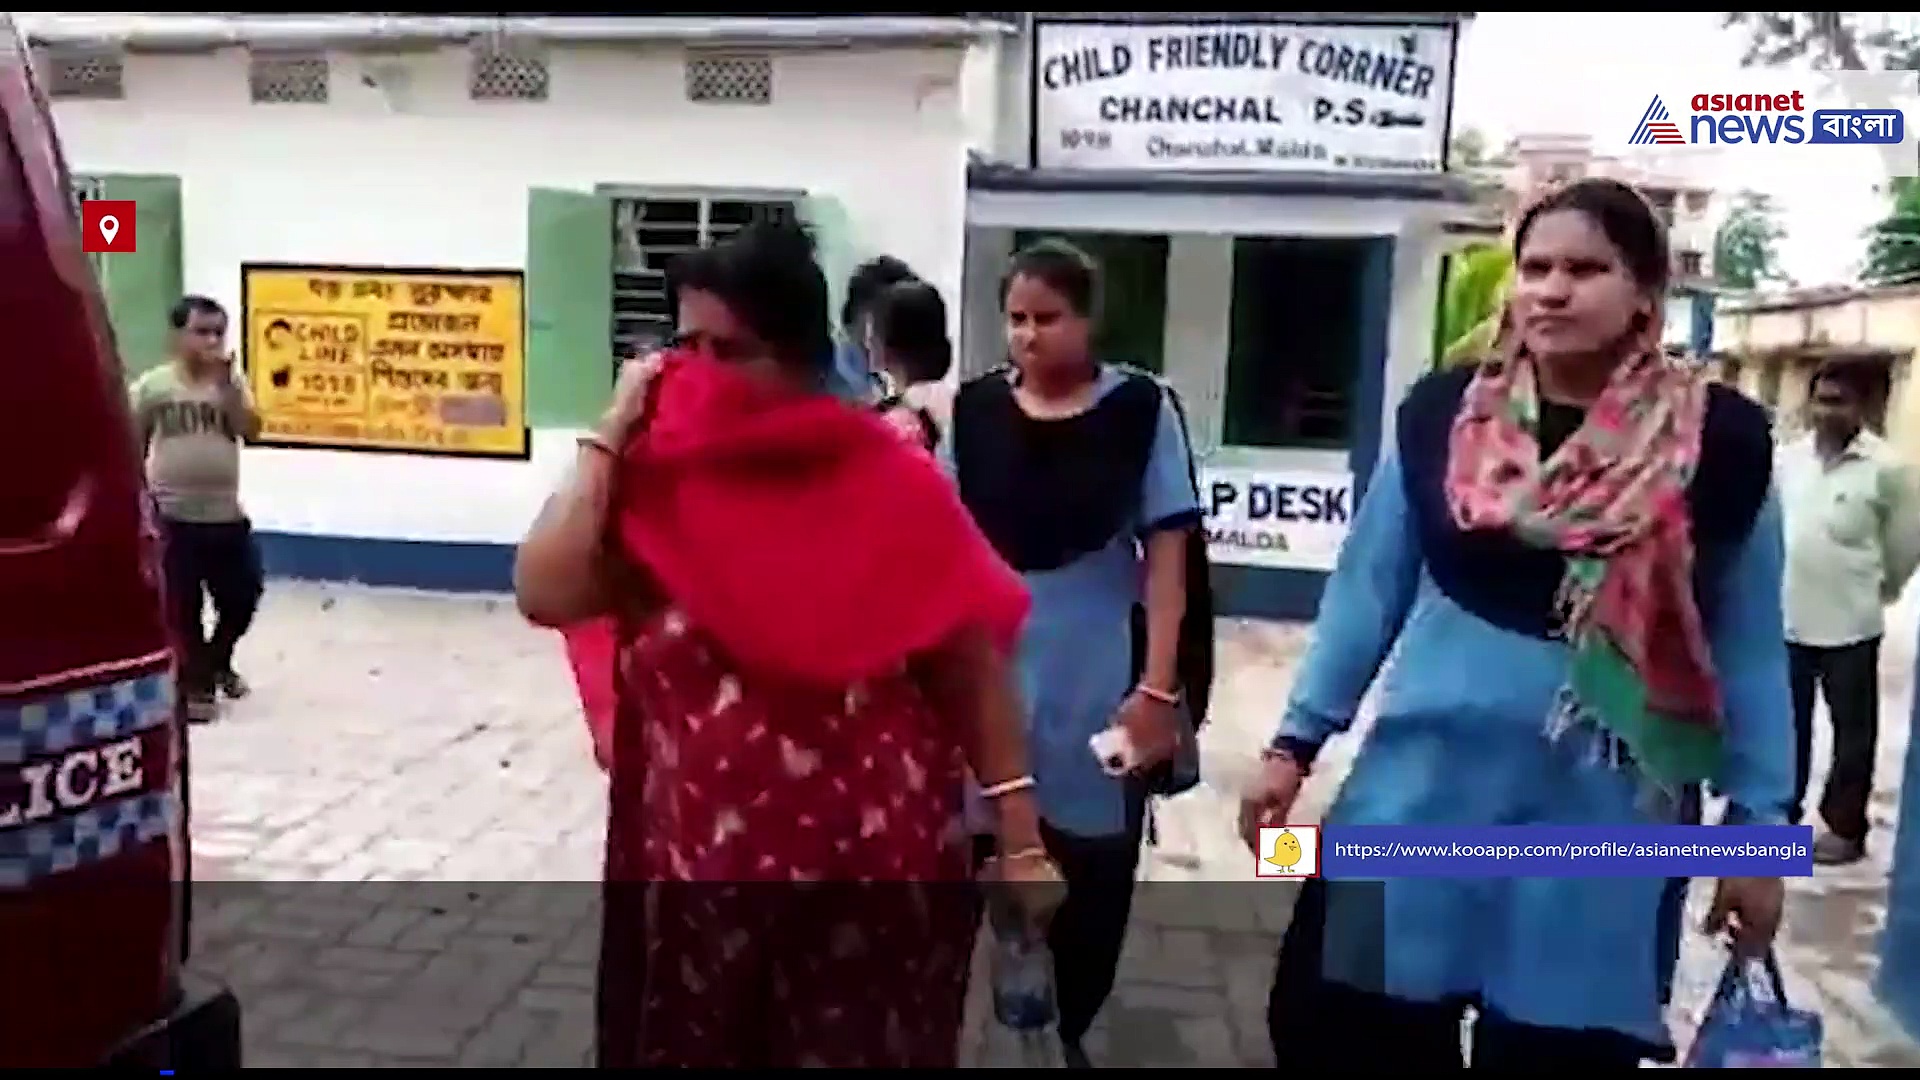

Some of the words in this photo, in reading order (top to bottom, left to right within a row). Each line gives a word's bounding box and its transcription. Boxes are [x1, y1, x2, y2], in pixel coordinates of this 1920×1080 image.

[1043, 45, 1131, 91] CHILD
[1148, 33, 1290, 72] FRIENDLY
[1299, 39, 1435, 99] CORRNER
[1100, 95, 1282, 124] CHANCHAL
[1249, 482, 1347, 523] DESK
